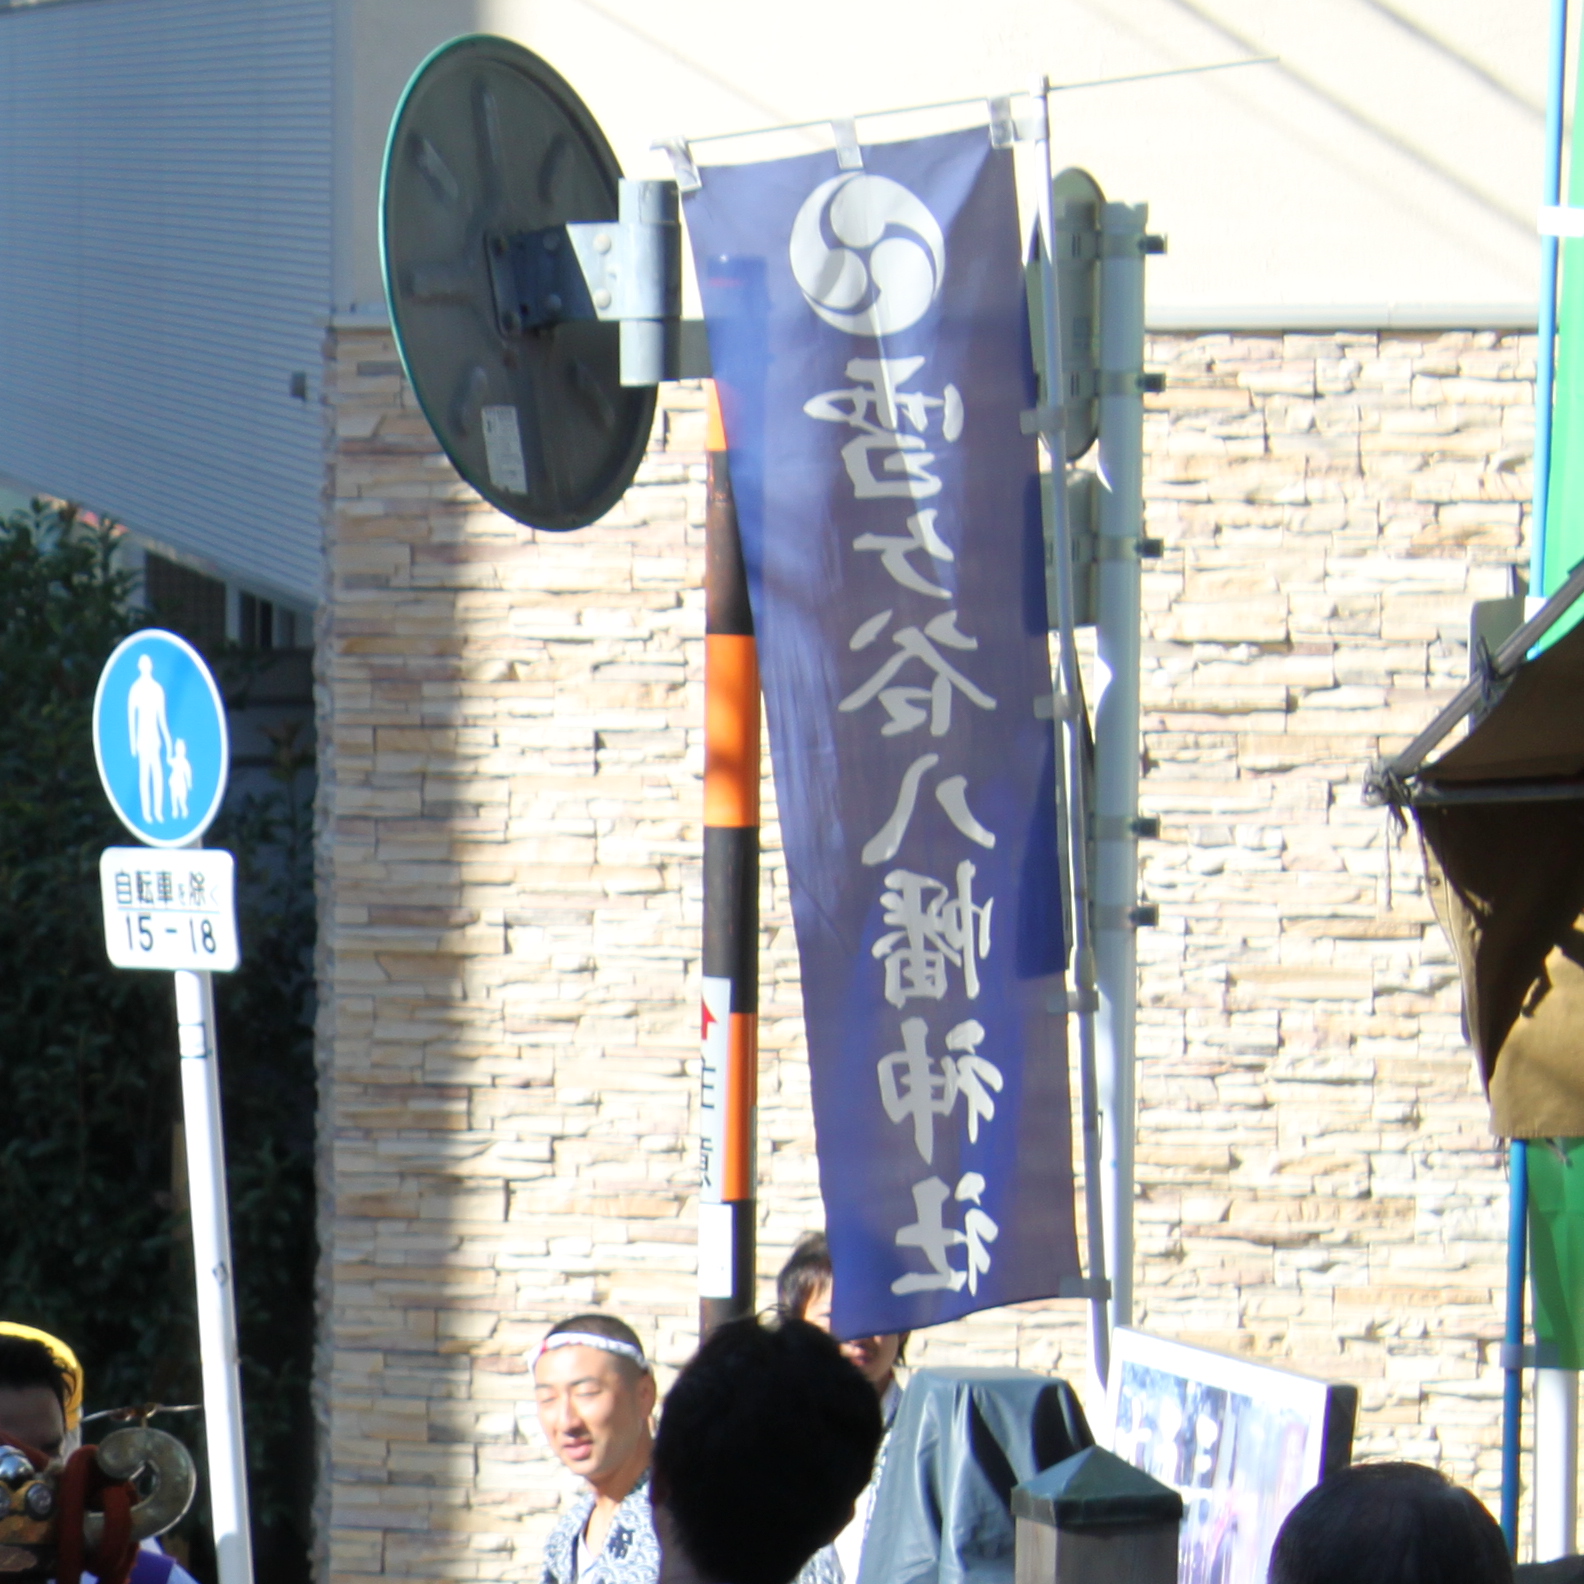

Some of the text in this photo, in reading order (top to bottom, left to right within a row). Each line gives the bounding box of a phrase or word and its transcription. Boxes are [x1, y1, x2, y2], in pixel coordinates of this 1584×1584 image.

[115, 869, 219, 907] 自転車を除く
